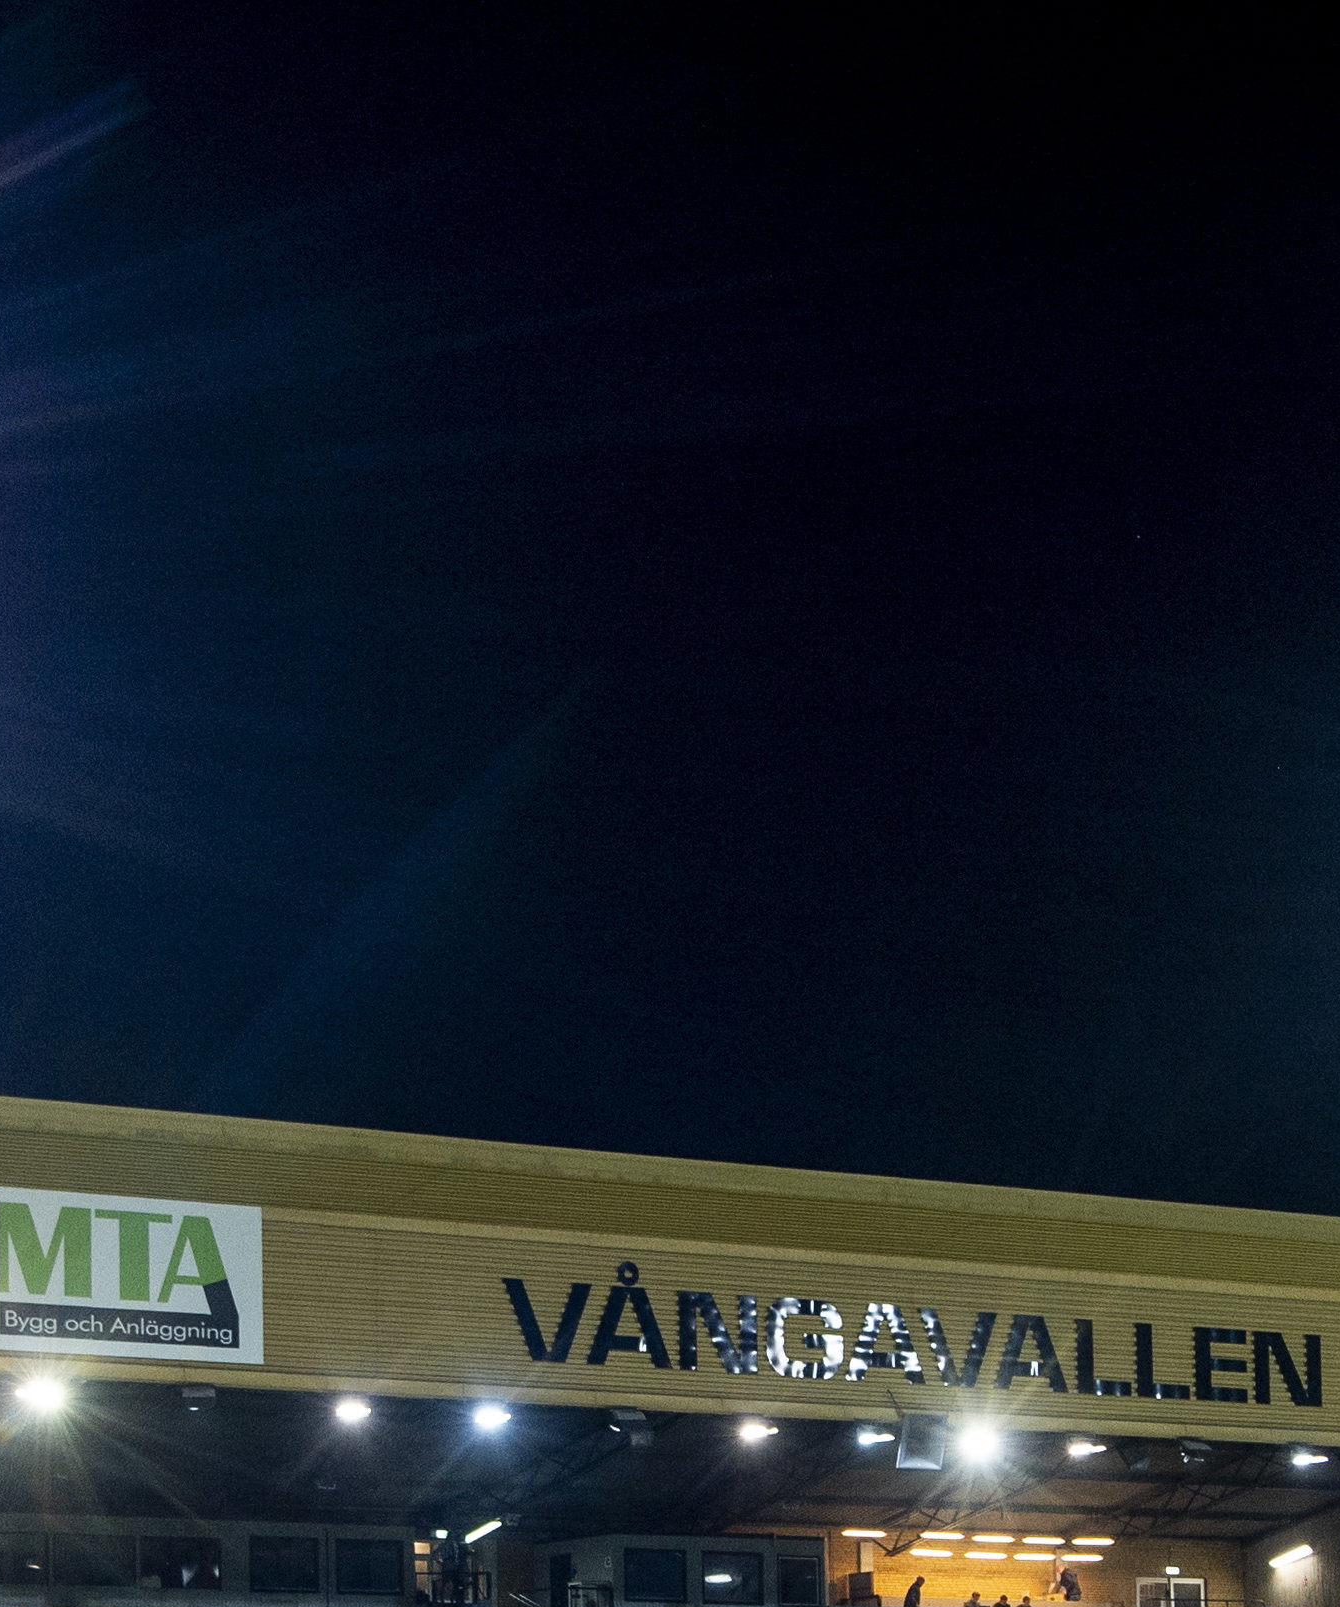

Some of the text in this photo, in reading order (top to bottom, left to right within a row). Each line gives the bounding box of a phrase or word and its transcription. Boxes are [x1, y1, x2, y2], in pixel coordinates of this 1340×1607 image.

[5, 1309, 233, 1345] Bygg och Anläggning
[502, 1261, 1323, 1408] VÅNGAVALLEN
